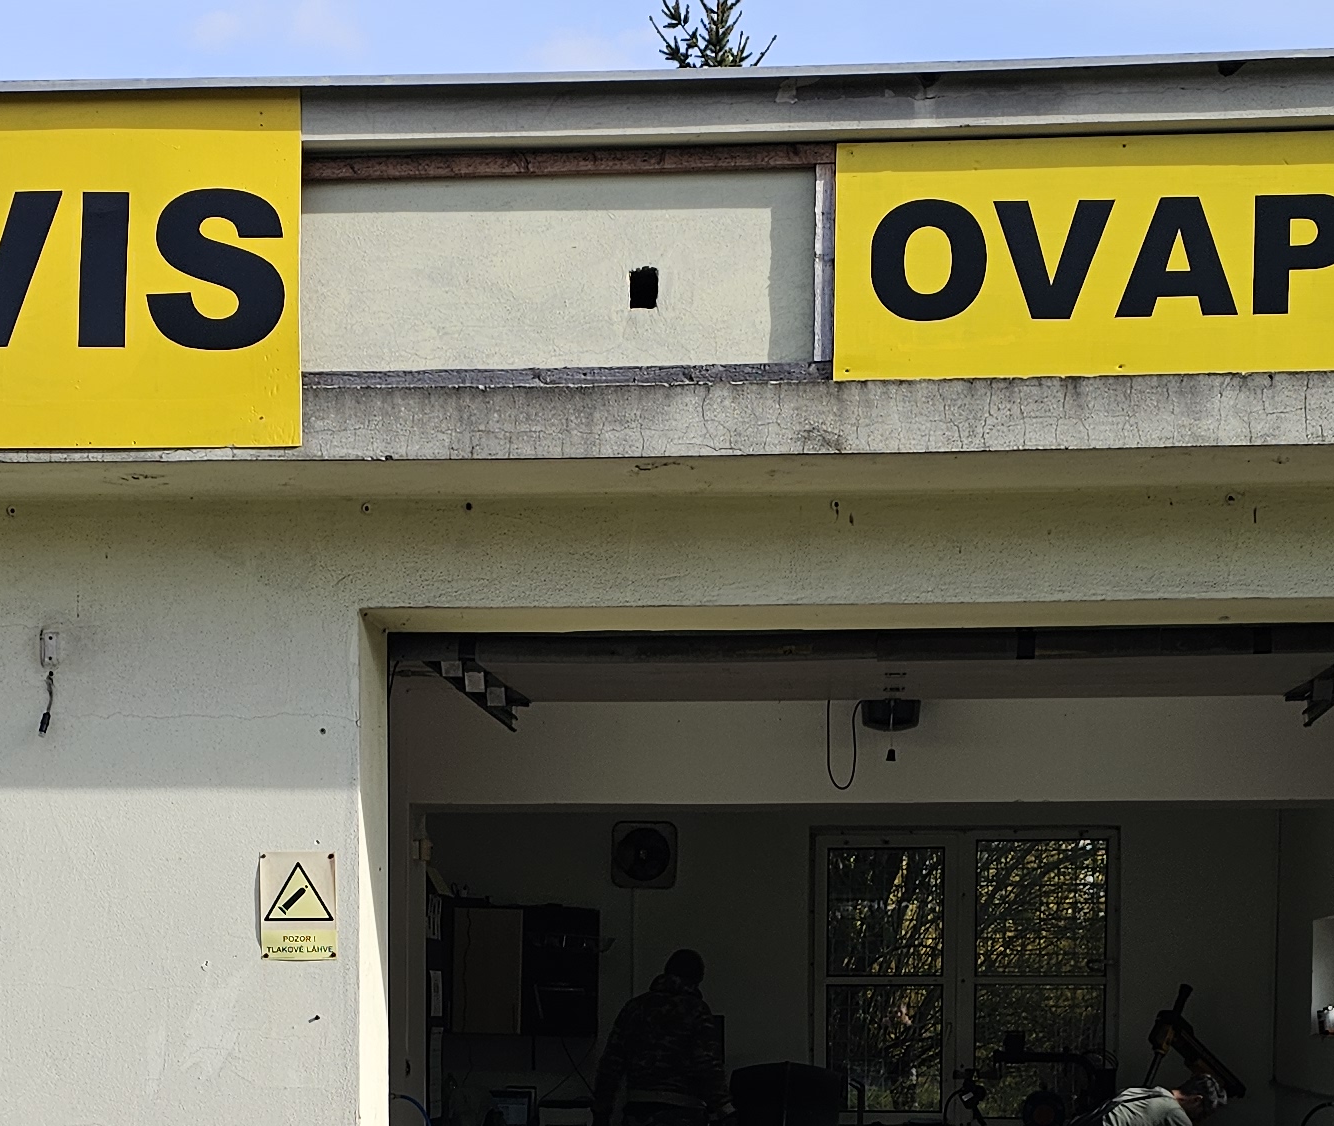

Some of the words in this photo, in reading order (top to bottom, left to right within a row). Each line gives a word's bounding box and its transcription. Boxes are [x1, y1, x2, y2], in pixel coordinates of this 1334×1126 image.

[282, 935, 311, 943] POZOR
[266, 945, 304, 953] TLAKOVÉ
[306, 945, 333, 953] LÁHVE
